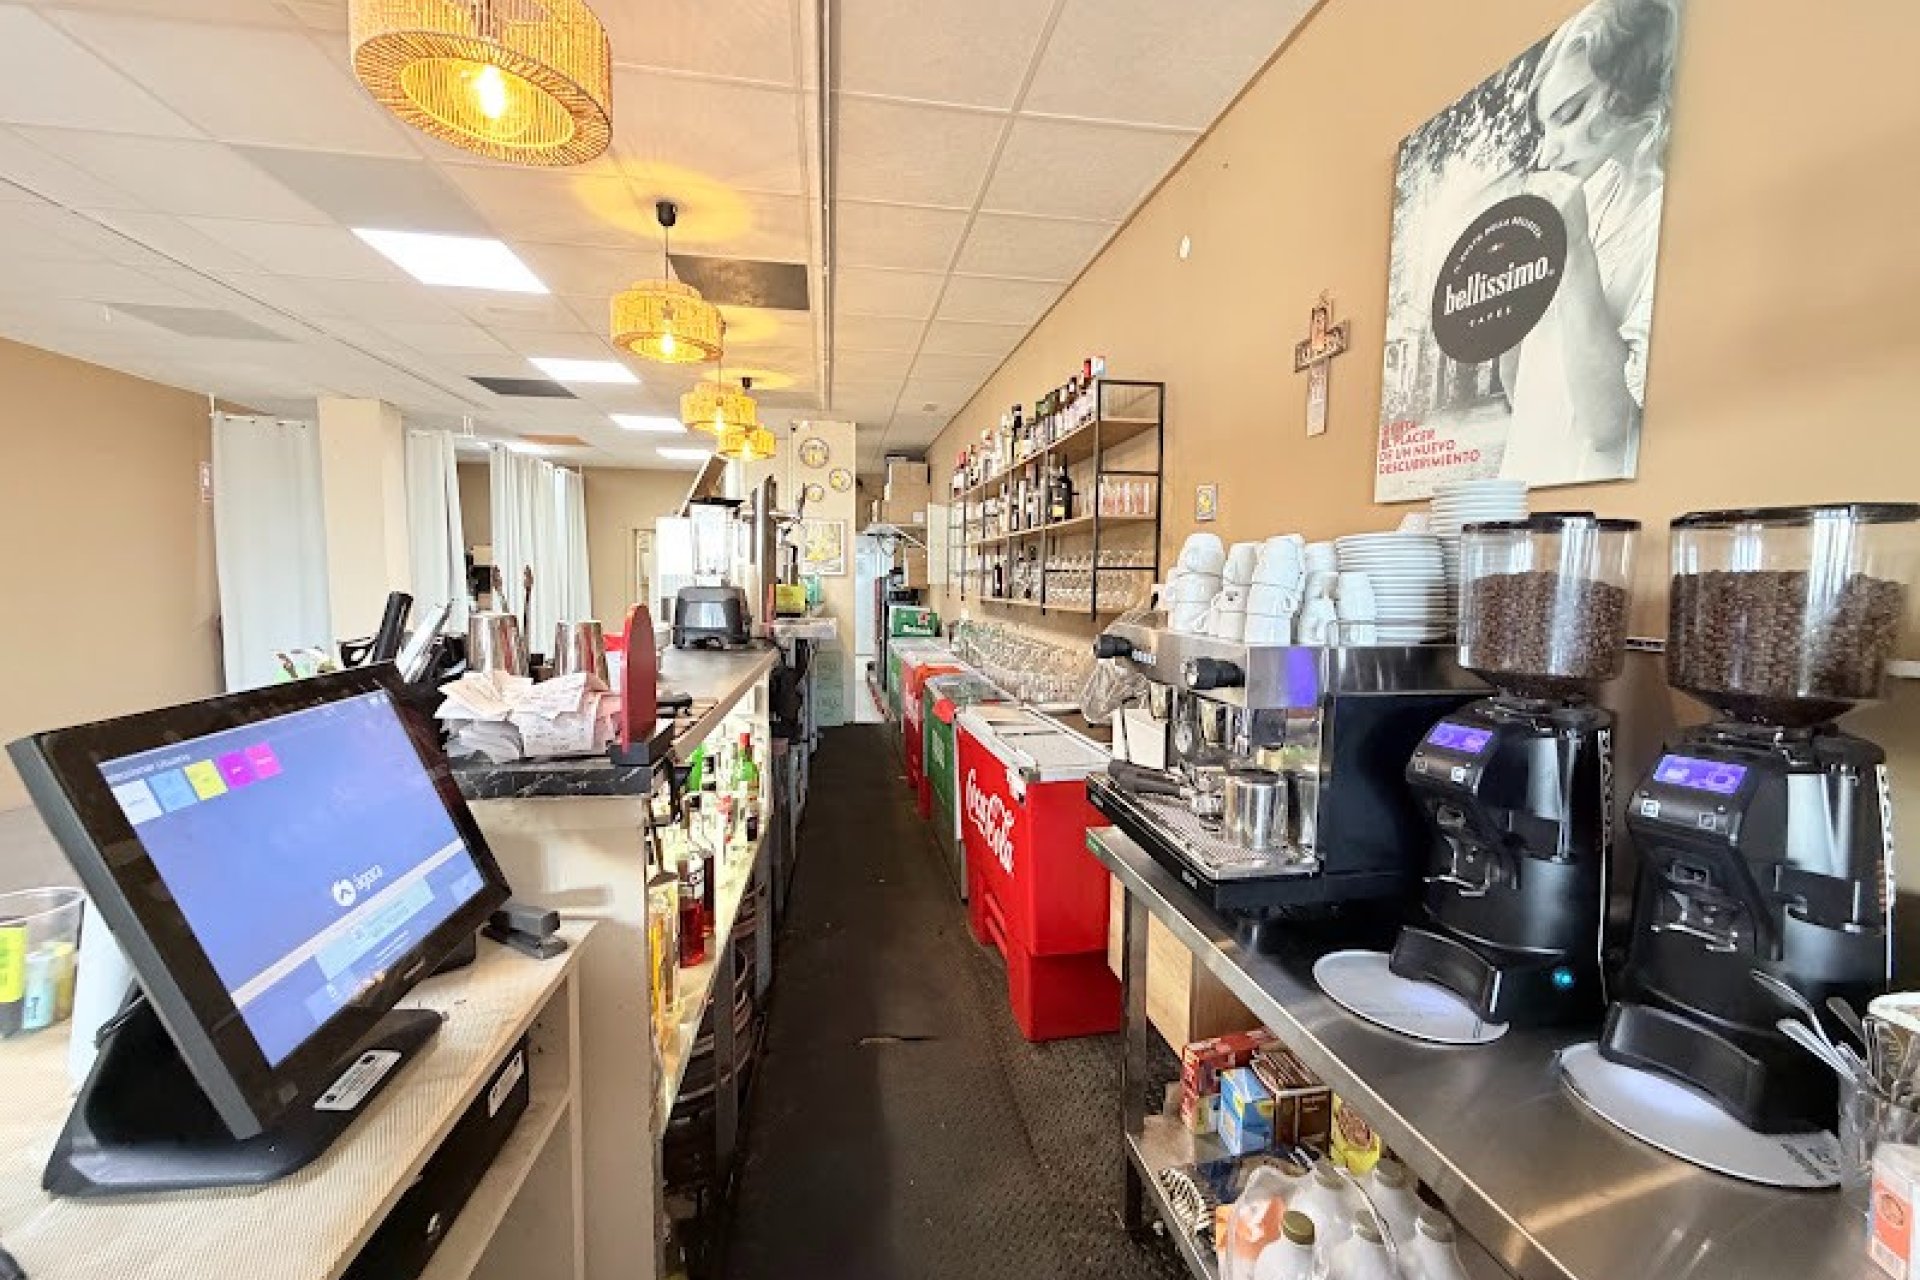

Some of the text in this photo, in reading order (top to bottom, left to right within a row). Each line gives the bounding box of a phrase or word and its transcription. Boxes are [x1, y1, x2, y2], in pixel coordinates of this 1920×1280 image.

[1393, 428, 1435, 447] PLACER
[1413, 439, 1456, 457] NUEVO
[1379, 449, 1481, 474] DESCUBRIMIENTO
